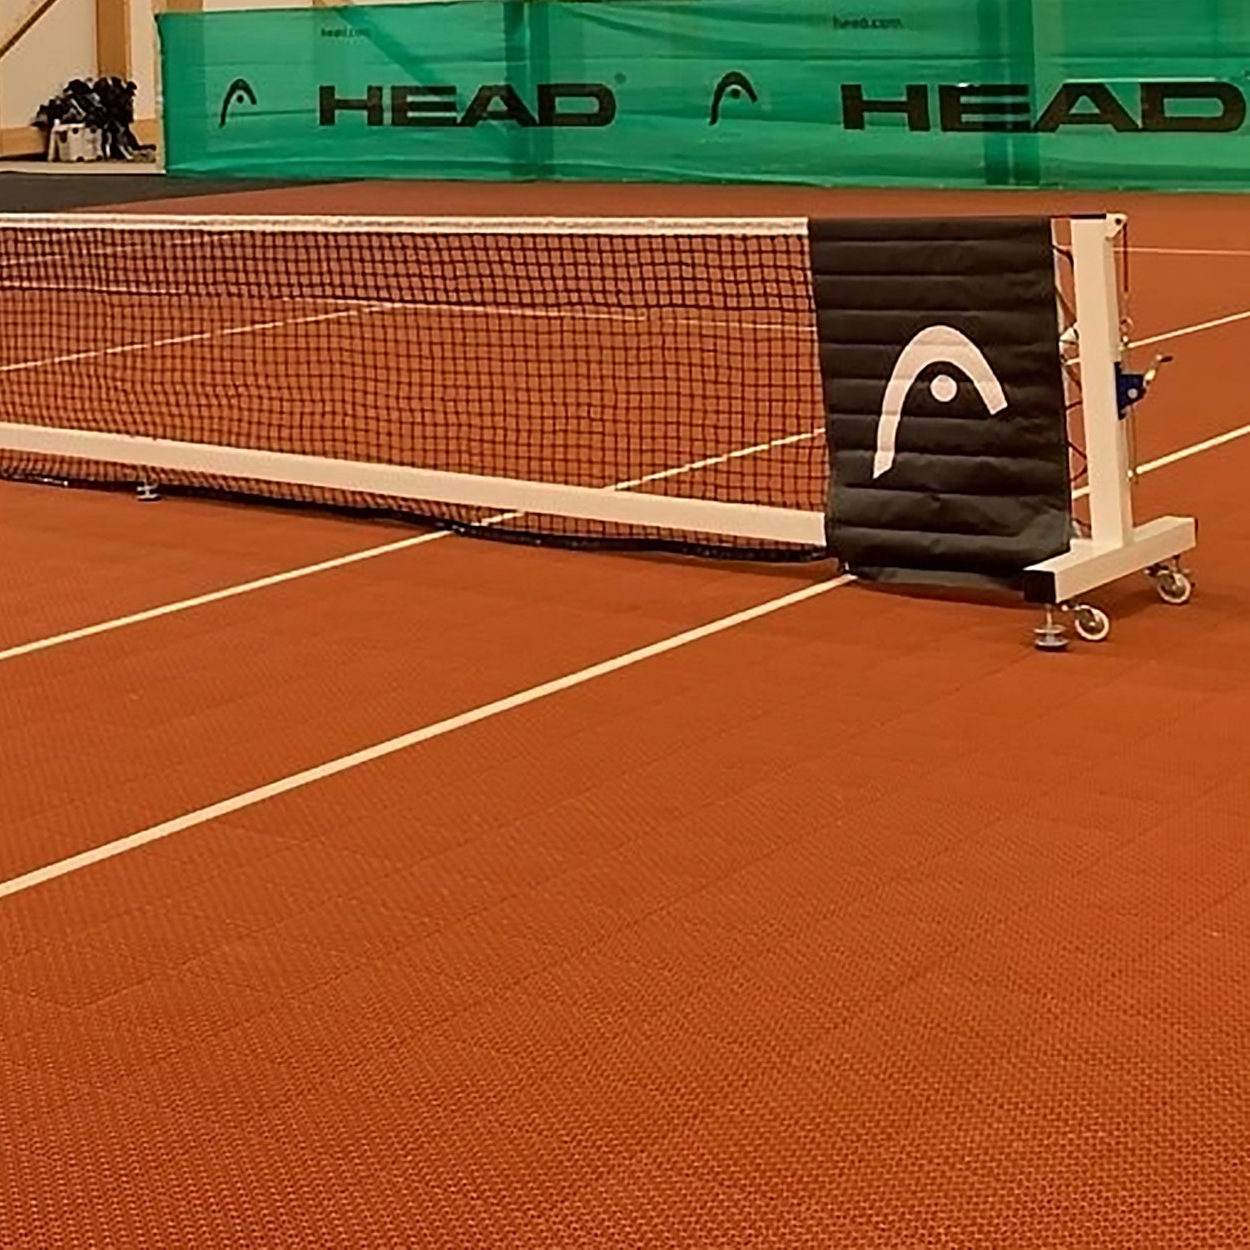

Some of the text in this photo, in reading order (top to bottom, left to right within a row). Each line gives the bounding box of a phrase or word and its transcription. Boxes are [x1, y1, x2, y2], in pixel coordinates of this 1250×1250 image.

[832, 15, 904, 30] head.com
[319, 84, 617, 127] HEAD
[841, 81, 1247, 133] HEAD
